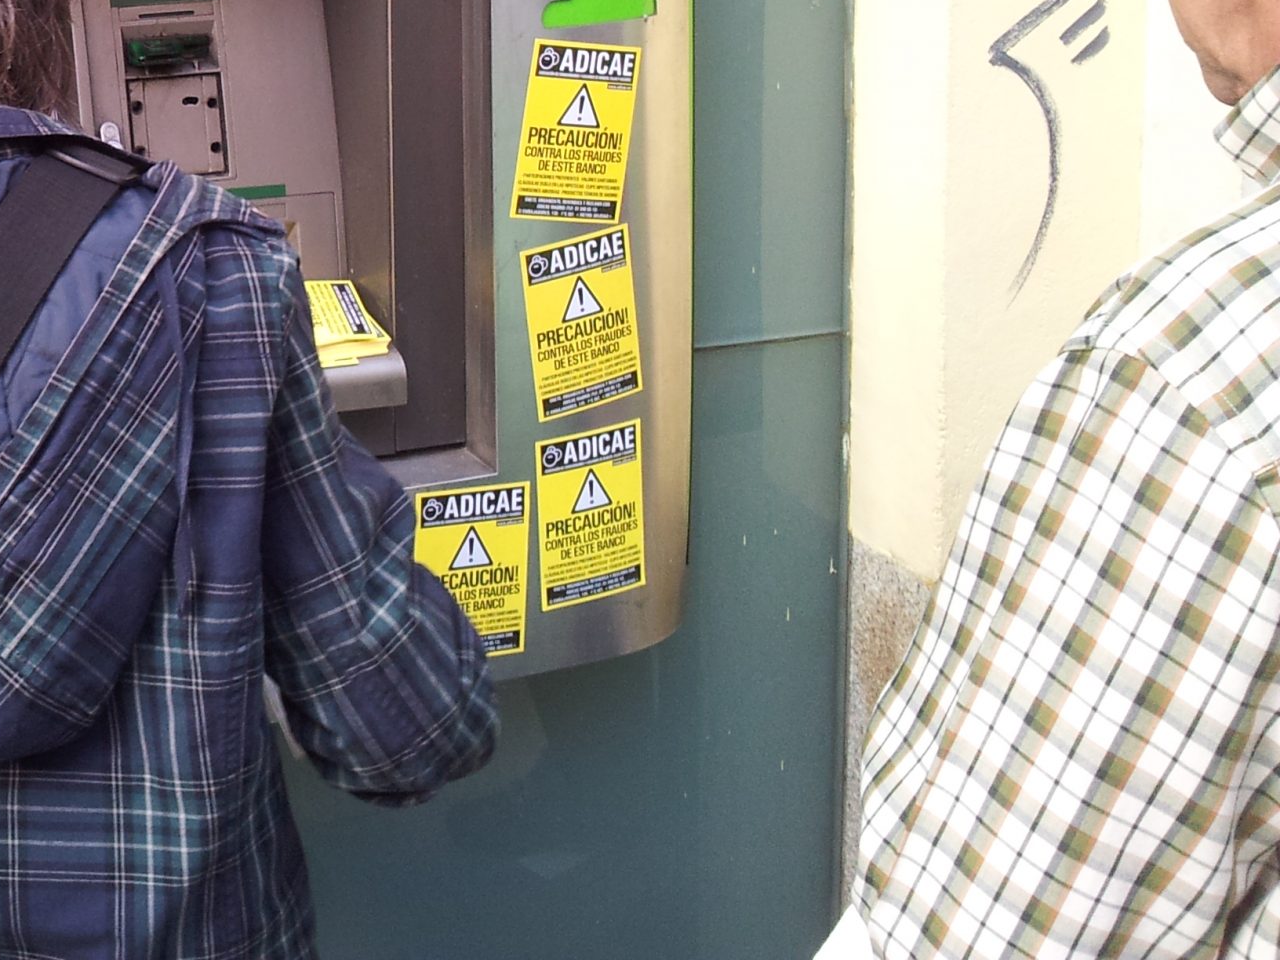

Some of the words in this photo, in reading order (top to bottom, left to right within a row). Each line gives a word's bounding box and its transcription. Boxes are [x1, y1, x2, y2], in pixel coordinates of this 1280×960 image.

[558, 48, 636, 77] ADICAE
[527, 126, 623, 150] PRECAUCIÓN!
[524, 145, 561, 159] CONTRA
[563, 148, 581, 160] LOS
[581, 149, 622, 163] FRAUDES
[537, 159, 551, 171] DE
[551, 160, 574, 173] ESTE
[574, 161, 606, 174] BANCO
[549, 231, 624, 273] ADICAE
[536, 307, 629, 350] PRECAUCIÓN!
[537, 342, 574, 363] CONTRA
[575, 337, 592, 352] LOS
[593, 324, 633, 346] FRAUDES
[553, 357, 566, 371] DE
[566, 350, 589, 367] ESTE
[589, 341, 620, 360] BANCO
[563, 427, 635, 464] ADICAE
[444, 489, 523, 520] ADICAE
[546, 500, 636, 540] PRECAUCIÓN!
[545, 533, 581, 552] CONTRA
[582, 529, 599, 543] LOS
[600, 518, 638, 538] FRAUDES
[560, 547, 572, 560] DE
[573, 541, 594, 557] ESTE
[595, 534, 625, 551] BANCO
[438, 562, 519, 591] ECAUCIÓN!
[459, 590, 477, 602] LOS
[478, 583, 520, 600] FRAUDES
[473, 597, 505, 612] BANCO
